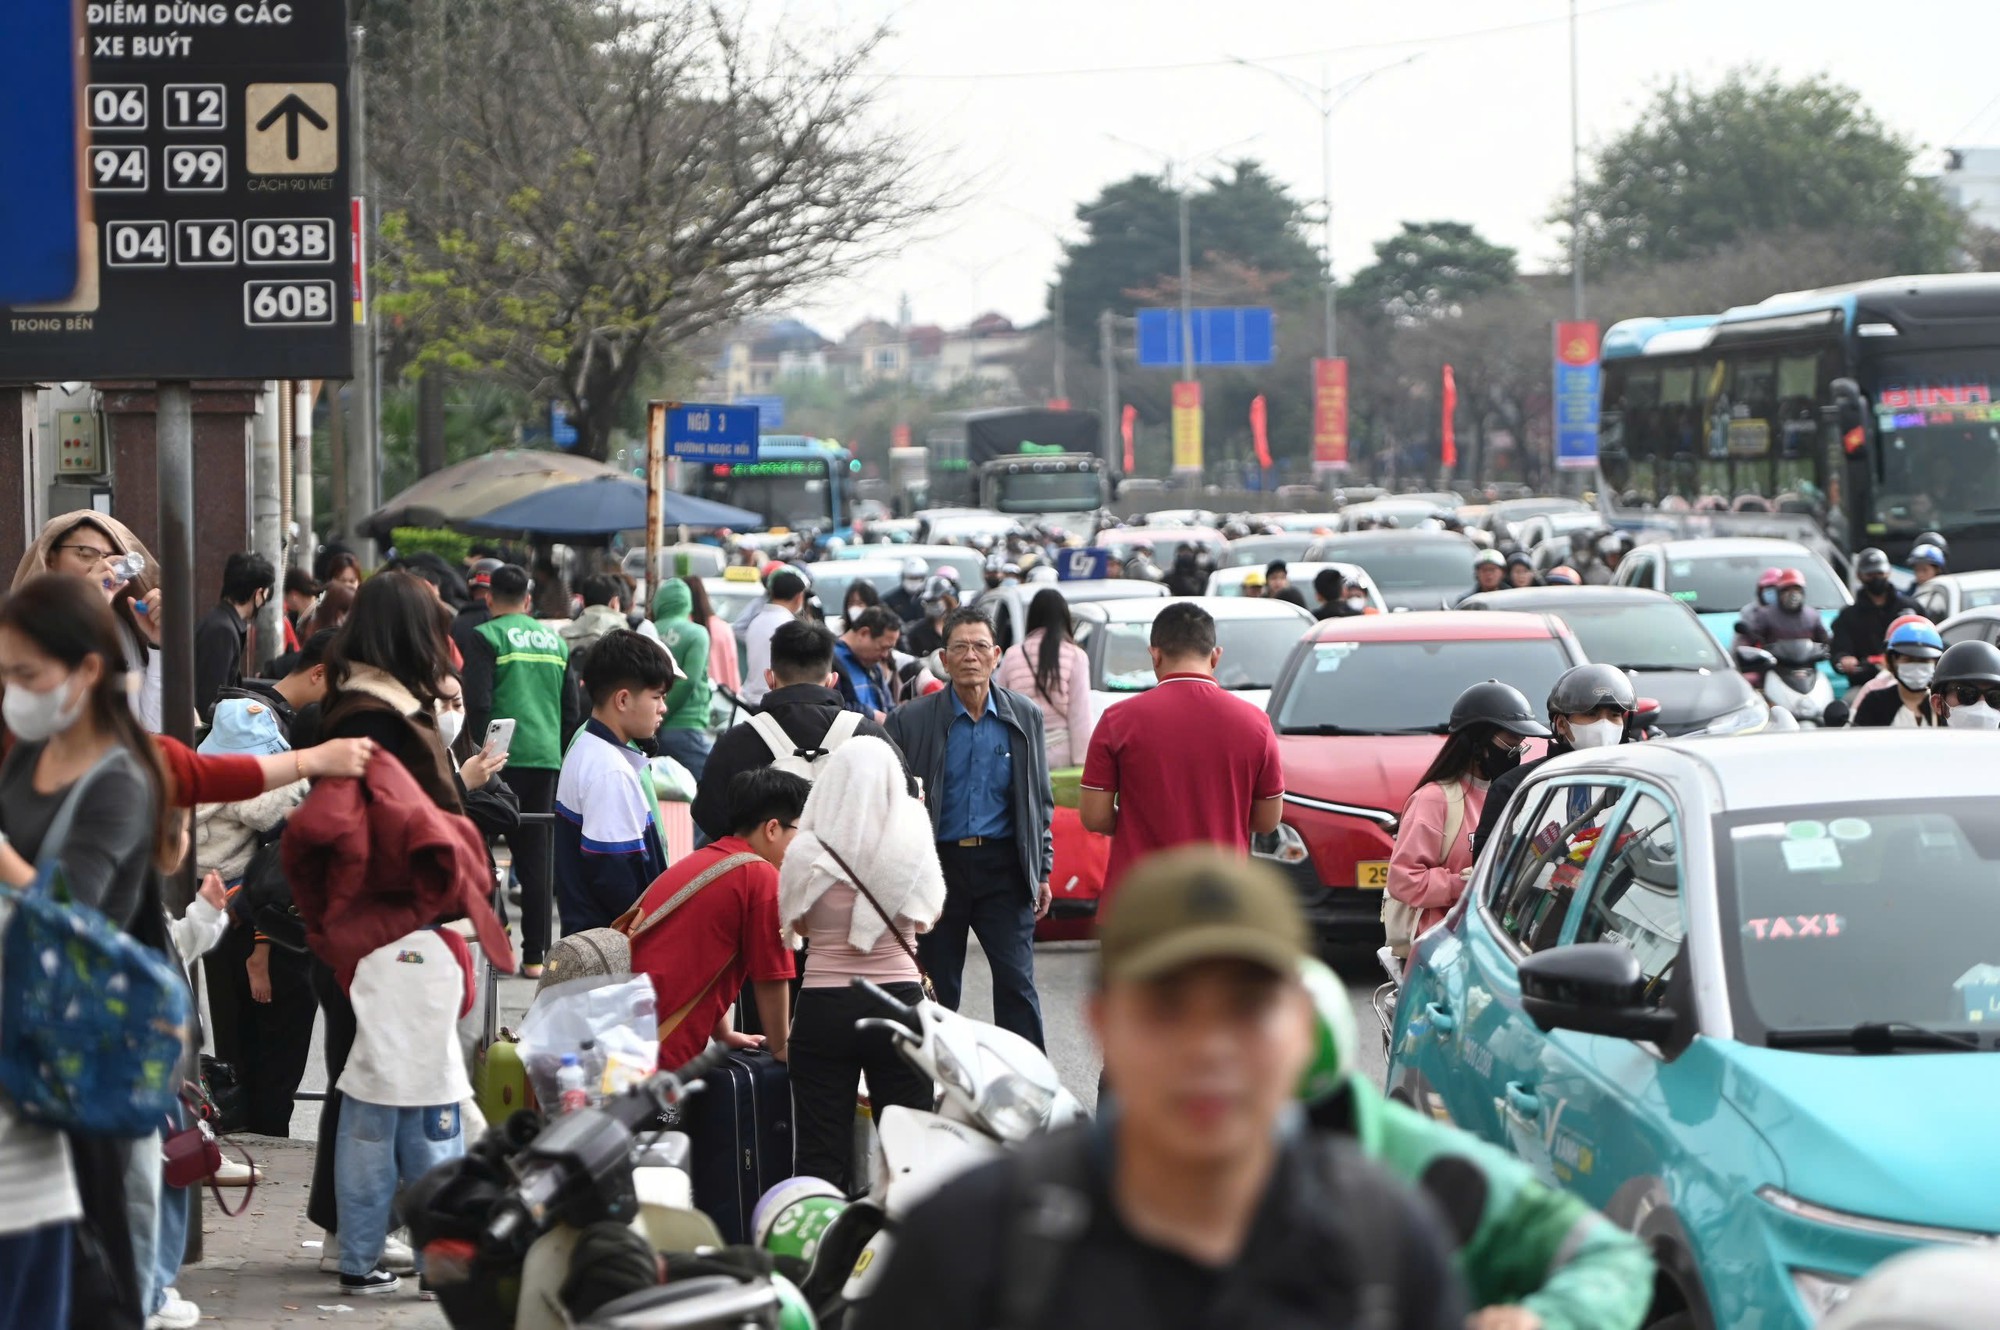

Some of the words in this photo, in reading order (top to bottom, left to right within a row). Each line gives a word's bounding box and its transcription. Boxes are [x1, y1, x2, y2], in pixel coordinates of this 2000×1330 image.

[154, 0, 228, 24] DỪNG
[234, 0, 293, 24] CÁC
[94, 36, 125, 56] XE
[132, 31, 193, 56] BUÝT
[94, 90, 143, 122] 06
[174, 90, 220, 122] 12
[94, 150, 144, 182] 94
[172, 151, 222, 183] 99
[247, 177, 287, 191] CÁCH
[290, 179, 306, 191] 90
[115, 226, 165, 259] 04
[186, 225, 232, 257] 16
[251, 224, 326, 256] 03B
[253, 285, 328, 318] 60B
[10, 318, 61, 331] TRONG
[65, 313, 94, 331] BẾN
[718, 413, 725, 432] 3
[507, 627, 558, 650] Grab
[1748, 913, 1840, 941] TAXI
